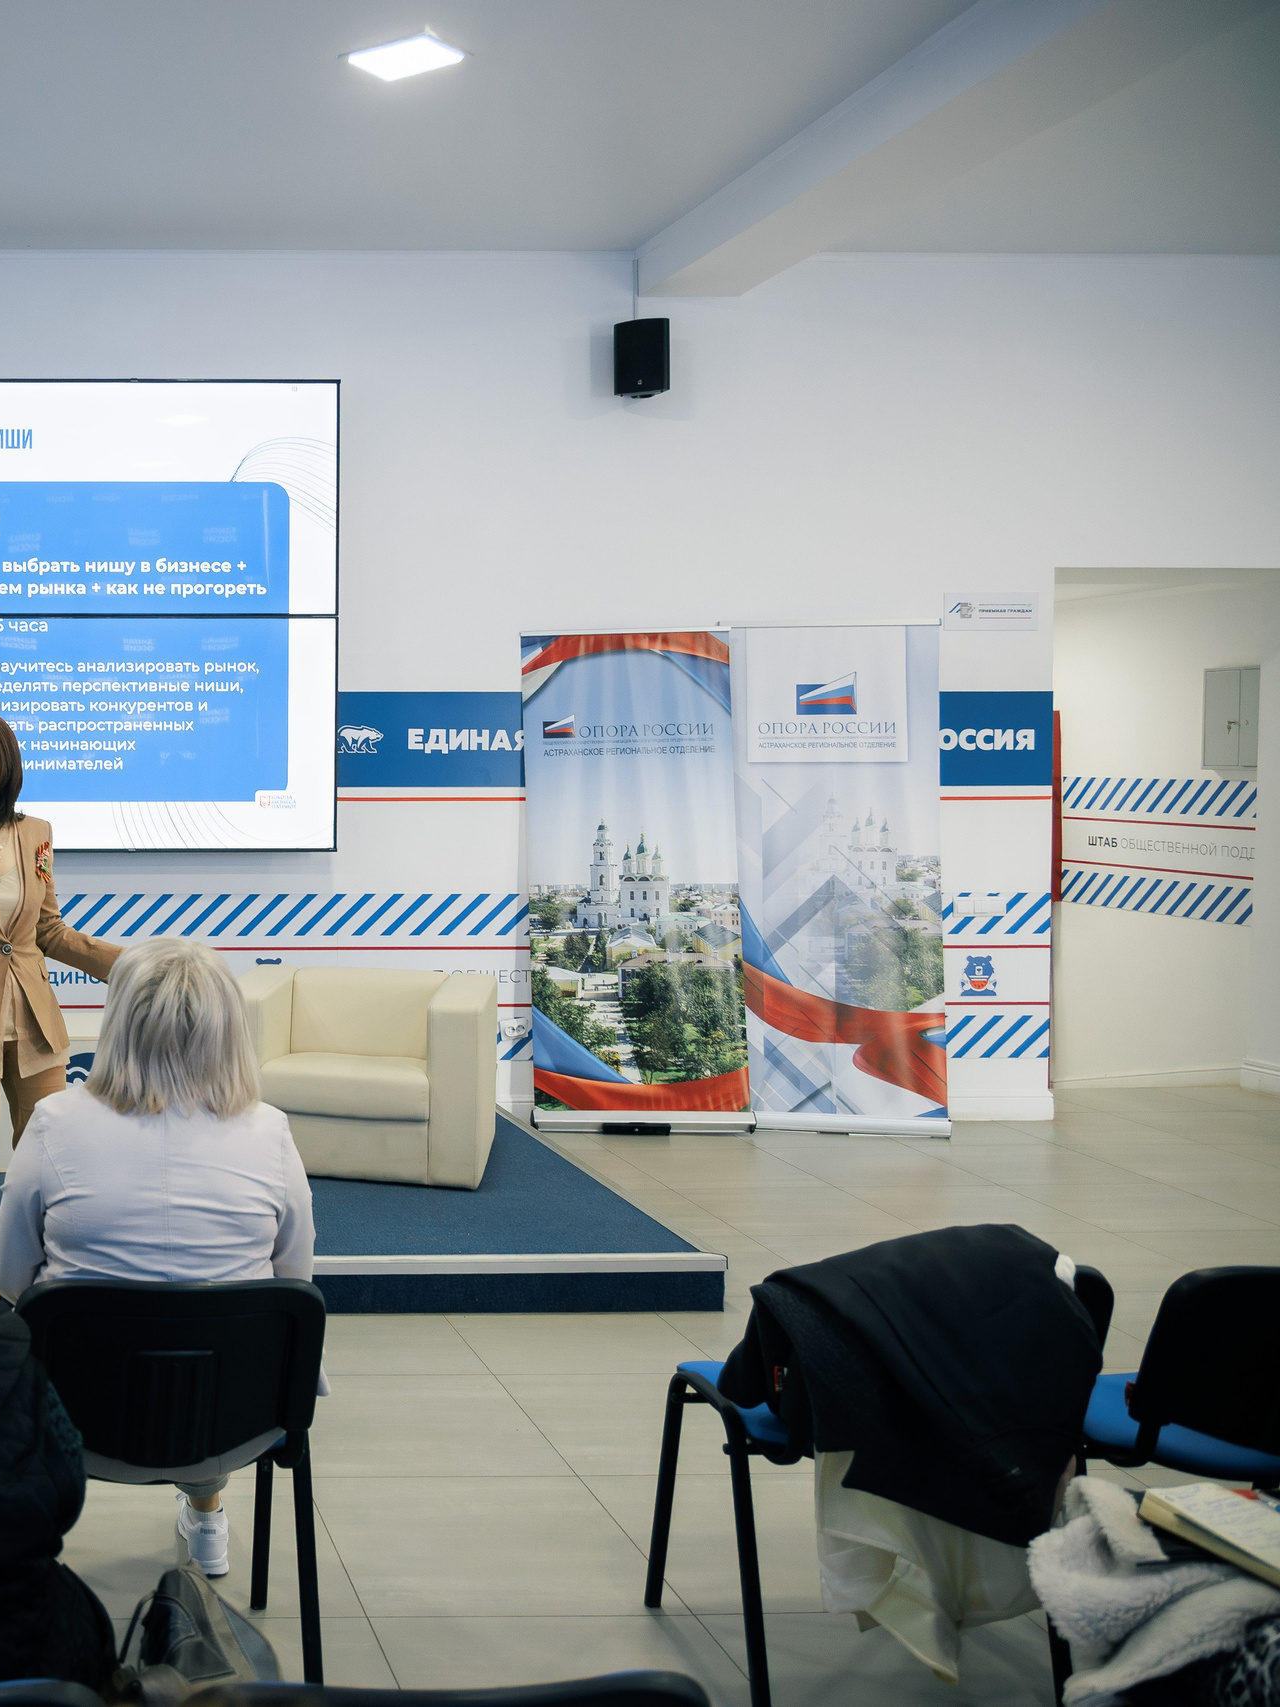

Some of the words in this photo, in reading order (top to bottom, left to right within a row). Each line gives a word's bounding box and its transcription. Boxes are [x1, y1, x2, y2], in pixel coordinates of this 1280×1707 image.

[2, 557, 81, 576] выбрать
[85, 561, 136, 576] нишу
[140, 561, 151, 573] в
[155, 557, 232, 573] бизнесе
[27, 583, 87, 598] рынка
[106, 583, 139, 595] как
[143, 583, 166, 595] не
[170, 583, 267, 599] прогореть
[8, 620, 49, 633] часа
[76, 661, 201, 675] анализировать
[204, 661, 260, 675] рынок,
[62, 681, 190, 695] перспективные
[194, 681, 244, 694] ниши,
[89, 701, 194, 715] конкурентов
[198, 701, 208, 712] и
[38, 720, 194, 735] распространенных
[579, 726, 638, 738] ОПОРА
[644, 723, 713, 736] РОССИИ
[758, 722, 817, 734] ОПОРА
[823, 722, 896, 734] РОССИИ
[30, 740, 136, 753] начинающих
[758, 741, 807, 749] АСТРАХАНСКОЕ
[808, 741, 858, 749] РЕГИОНАЛЬНОЕ
[859, 741, 897, 749] ОТДЕЛЕНИЕ
[939, 728, 1035, 751] ОССИЯ
[544, 748, 604, 757] АСТРАХАНСКОЕ
[606, 746, 667, 755] РЕГИОНАЛЬНОЕ
[669, 745, 716, 754] ОТДЕЛЕНИЕ
[23, 757, 123, 770] инимателей
[1088, 836, 1118, 848] ШТАБ
[1120, 837, 1218, 857] ОБЩЕСТВЕННОЙ
